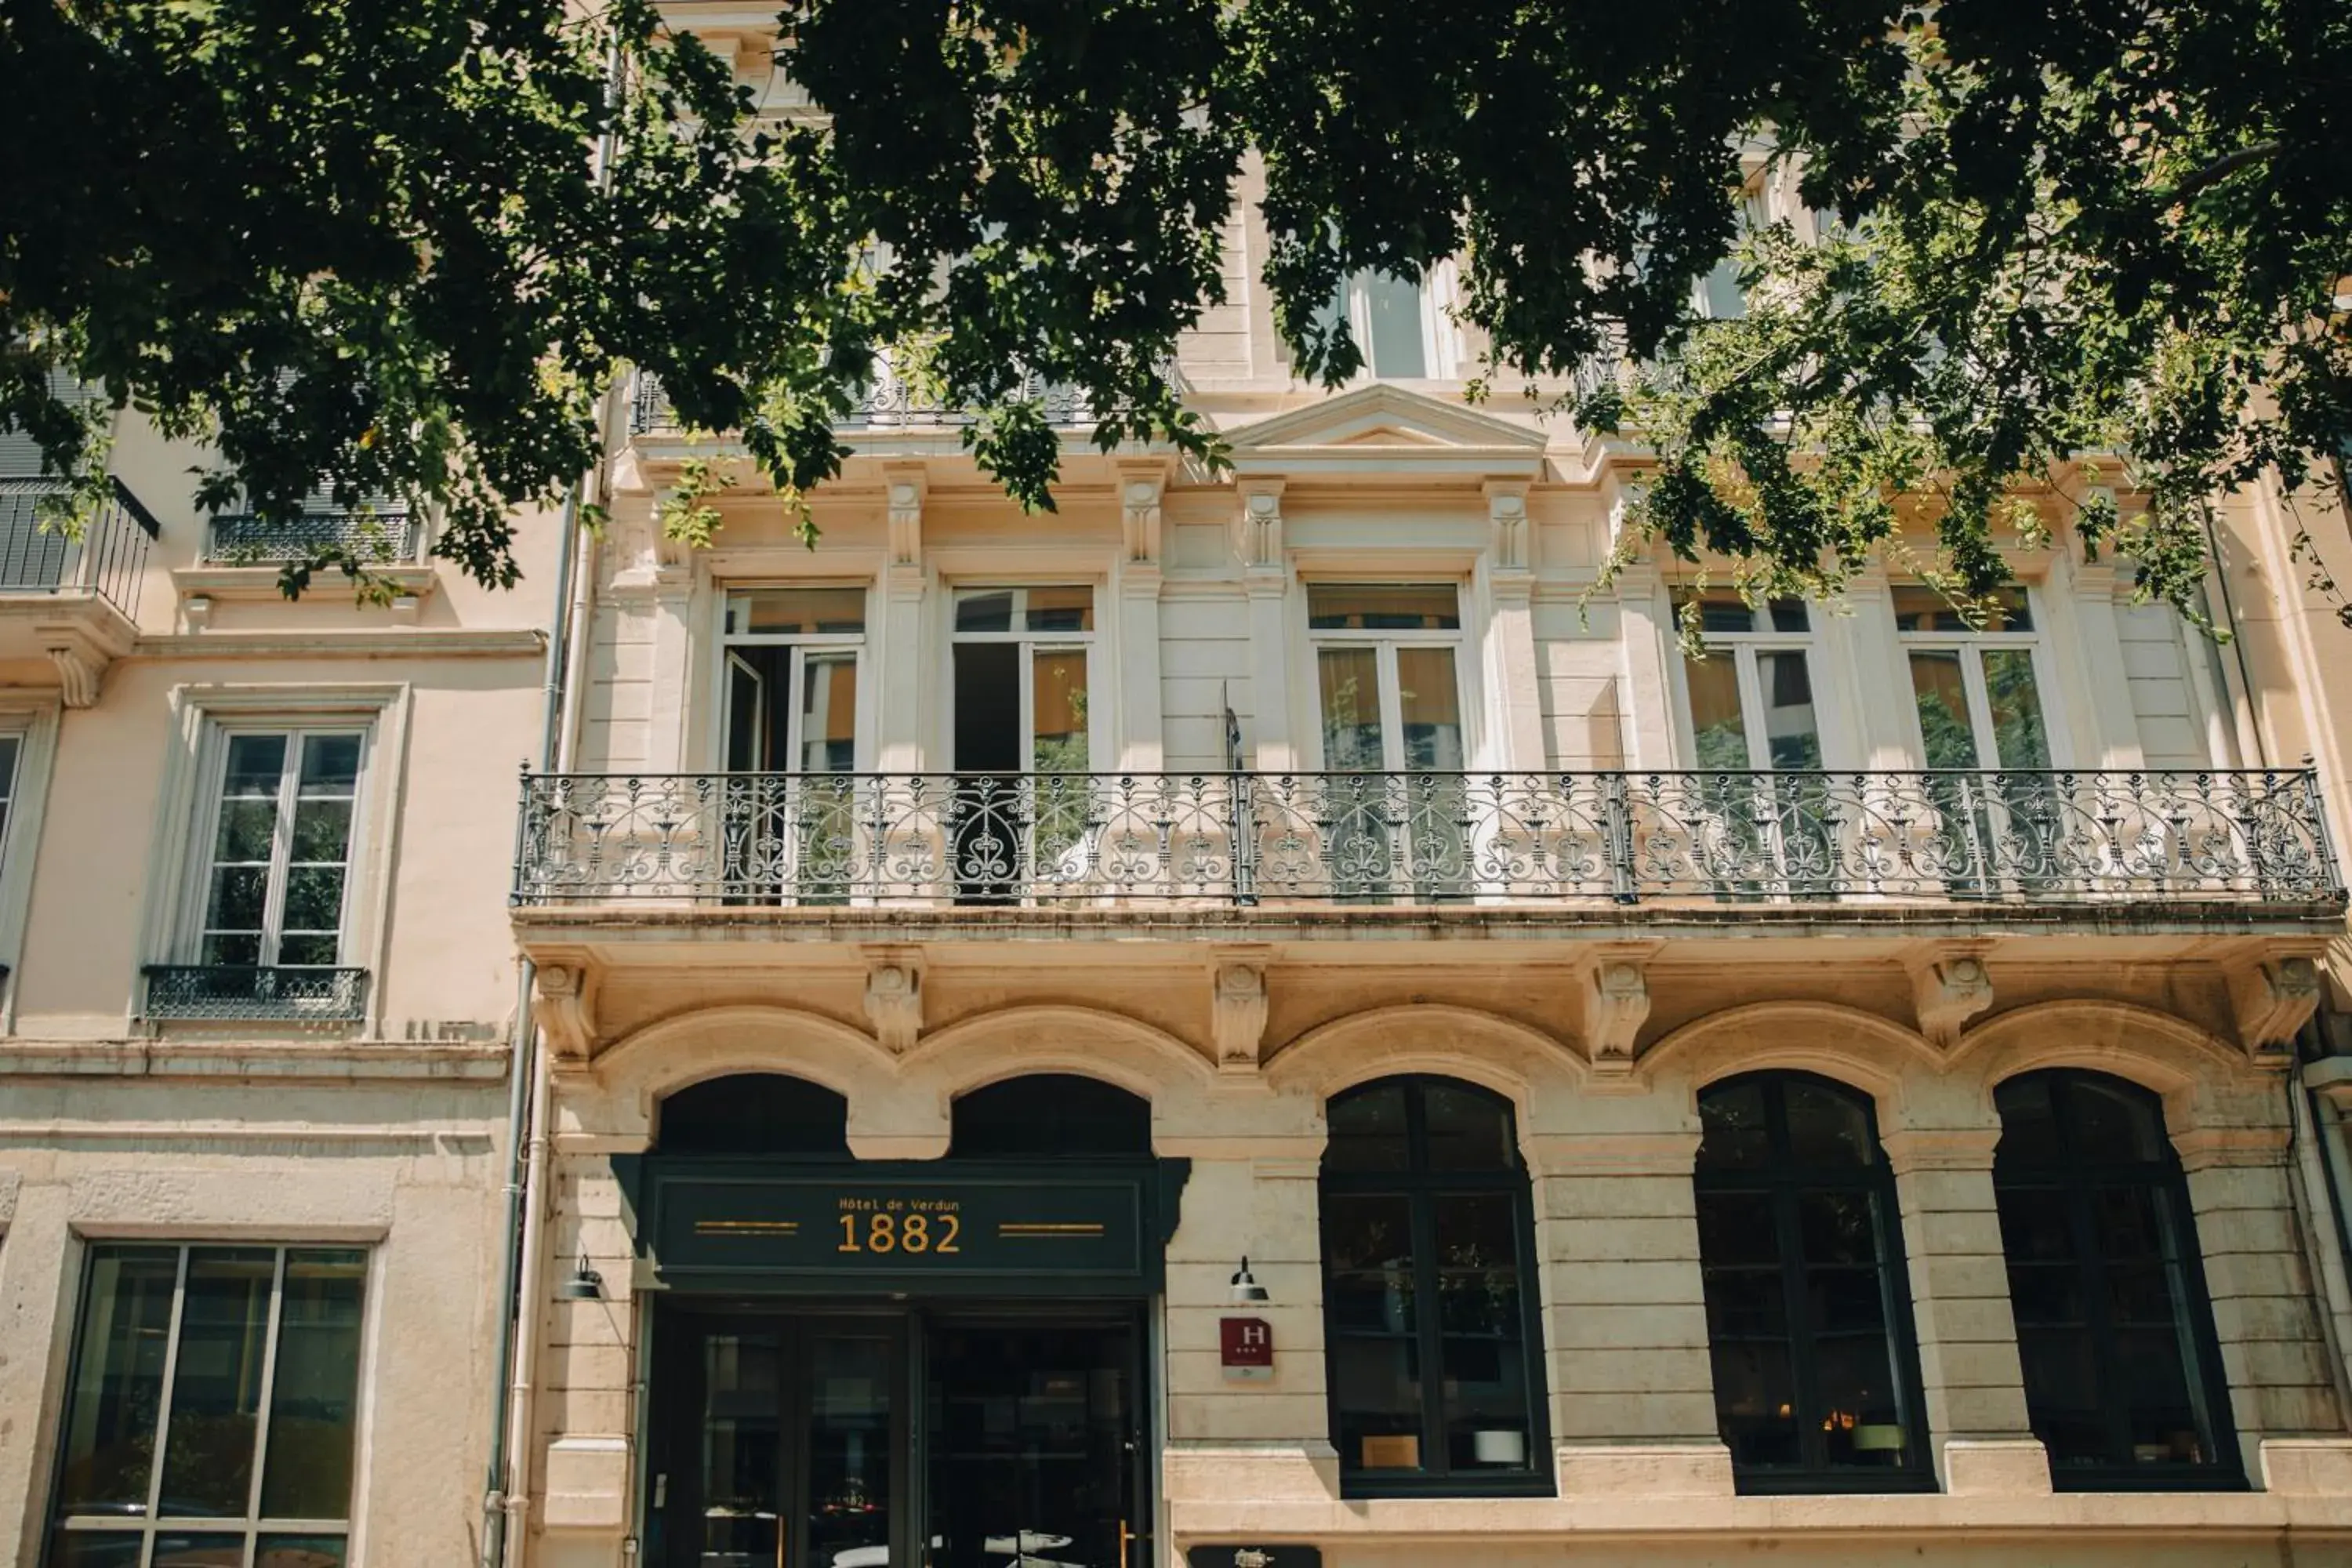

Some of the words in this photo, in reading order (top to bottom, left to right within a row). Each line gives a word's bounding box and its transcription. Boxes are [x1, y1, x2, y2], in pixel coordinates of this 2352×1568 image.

[840, 1198, 878, 1210] Hôtel
[886, 1199, 903, 1210] de
[910, 1199, 959, 1211] Verdun
[838, 1214, 960, 1253] 1882
[1243, 1326, 1265, 1345] H
